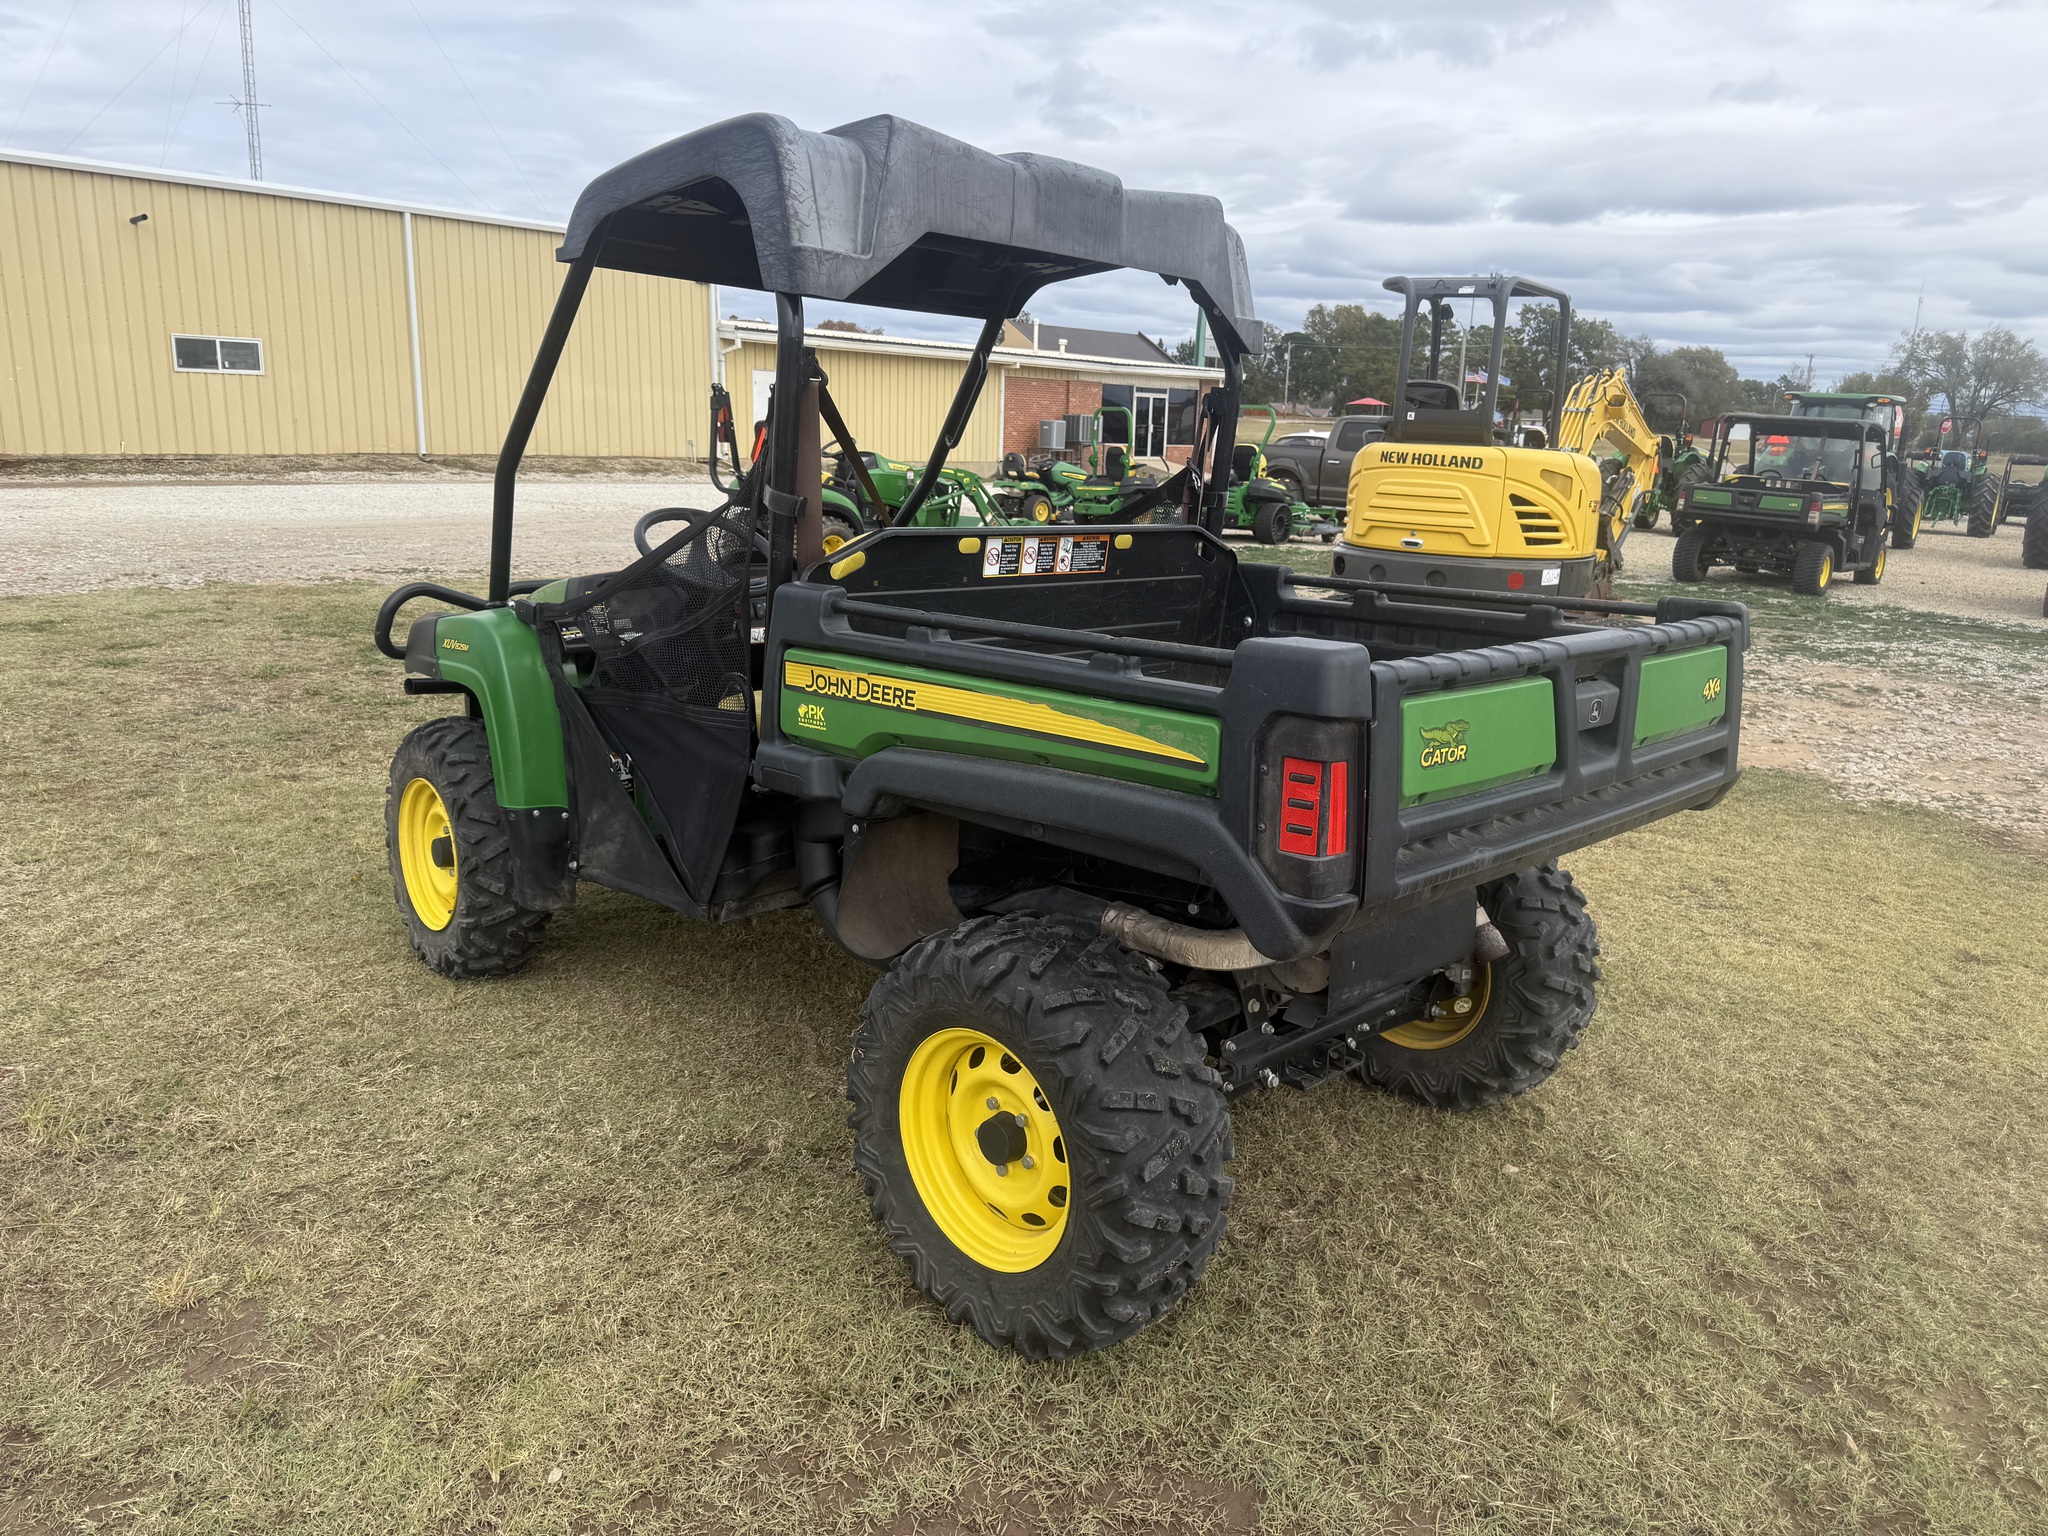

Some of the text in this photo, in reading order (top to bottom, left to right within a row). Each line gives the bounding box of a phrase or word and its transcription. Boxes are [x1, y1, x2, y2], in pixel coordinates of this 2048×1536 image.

[1380, 450, 1484, 469] NEW HOLLAND
[805, 669, 917, 708] JOHN DEERE
[1420, 744, 1468, 767] GATOR
